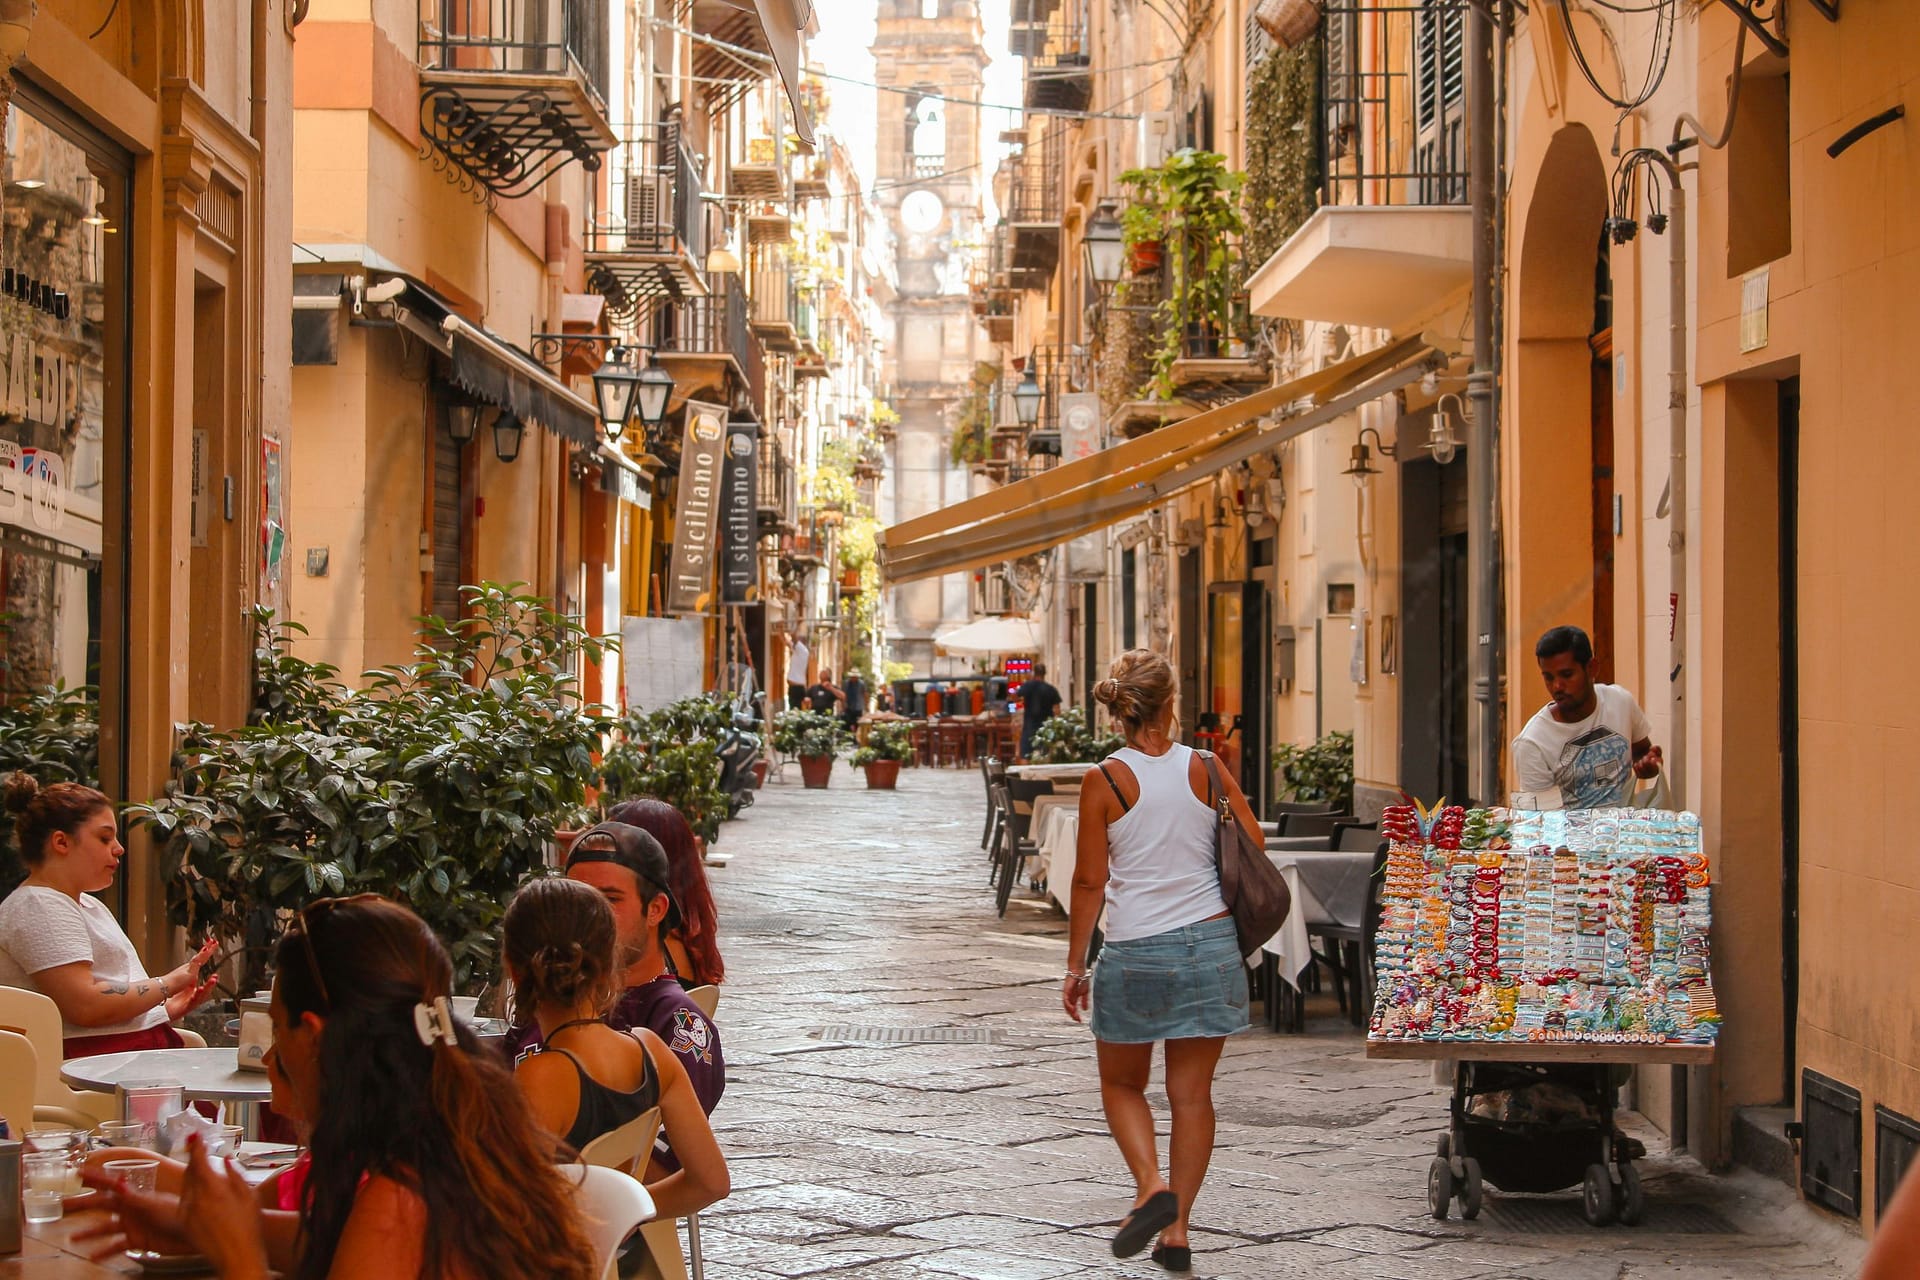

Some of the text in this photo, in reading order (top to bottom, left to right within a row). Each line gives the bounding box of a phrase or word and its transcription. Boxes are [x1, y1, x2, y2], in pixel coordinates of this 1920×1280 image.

[684, 453, 714, 565] siciliano
[729, 467, 749, 562] siciliano
[679, 575, 702, 592] il
[729, 571, 749, 585] il
